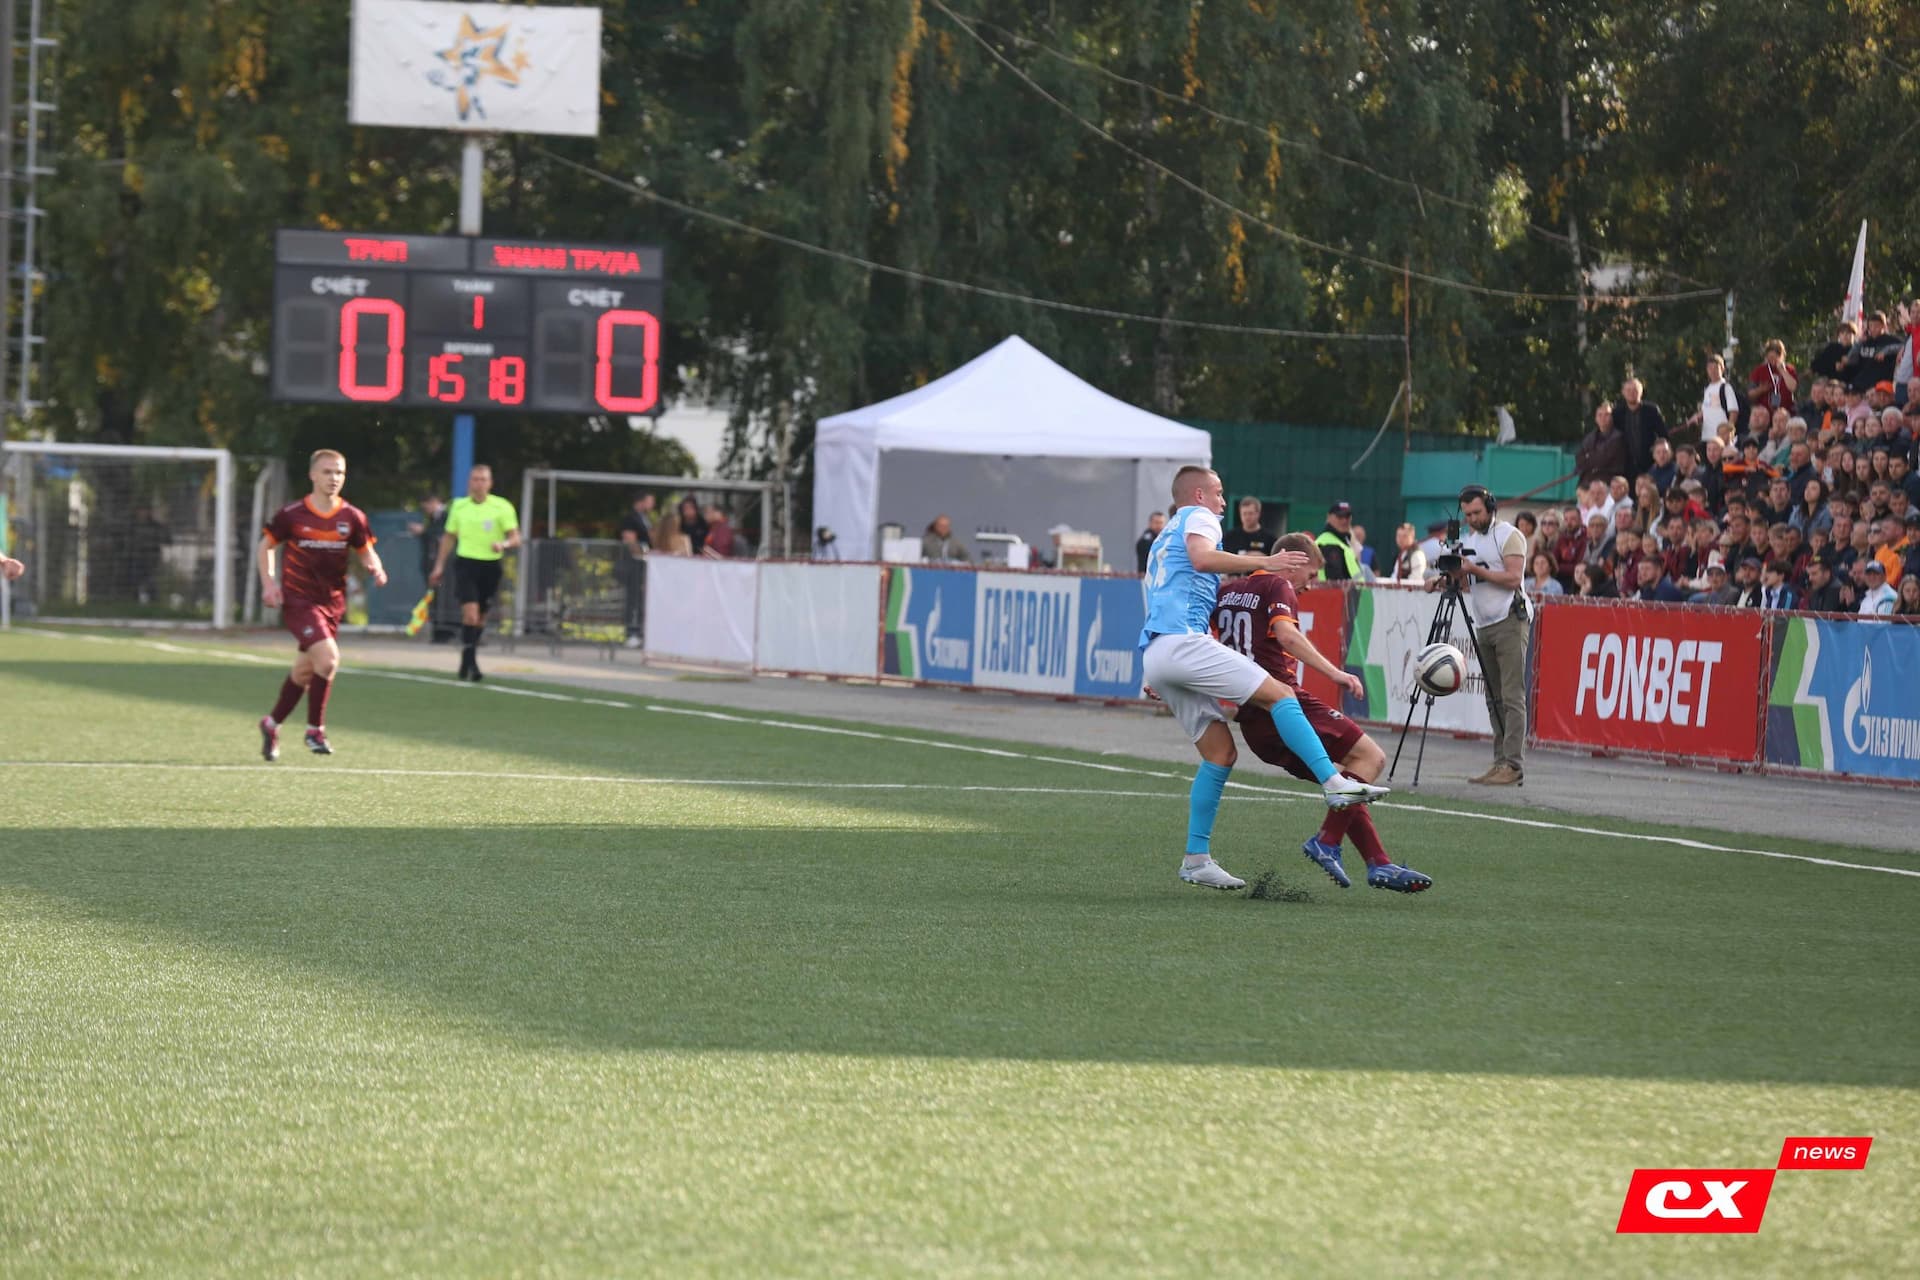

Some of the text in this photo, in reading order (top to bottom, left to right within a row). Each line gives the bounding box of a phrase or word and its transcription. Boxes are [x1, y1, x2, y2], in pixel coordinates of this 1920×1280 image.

[311, 276, 370, 296] СЧЁТ
[569, 248, 641, 276] ТРУДА
[473, 295, 485, 330] 1
[567, 288, 625, 308] СЧЁТ
[339, 298, 405, 401] 0
[595, 310, 660, 412] 0
[429, 354, 525, 404] 15 18
[981, 587, 1070, 678] ГАЗПРОМ
[1218, 608, 1255, 662] 20
[1575, 633, 1723, 728] FONBET
